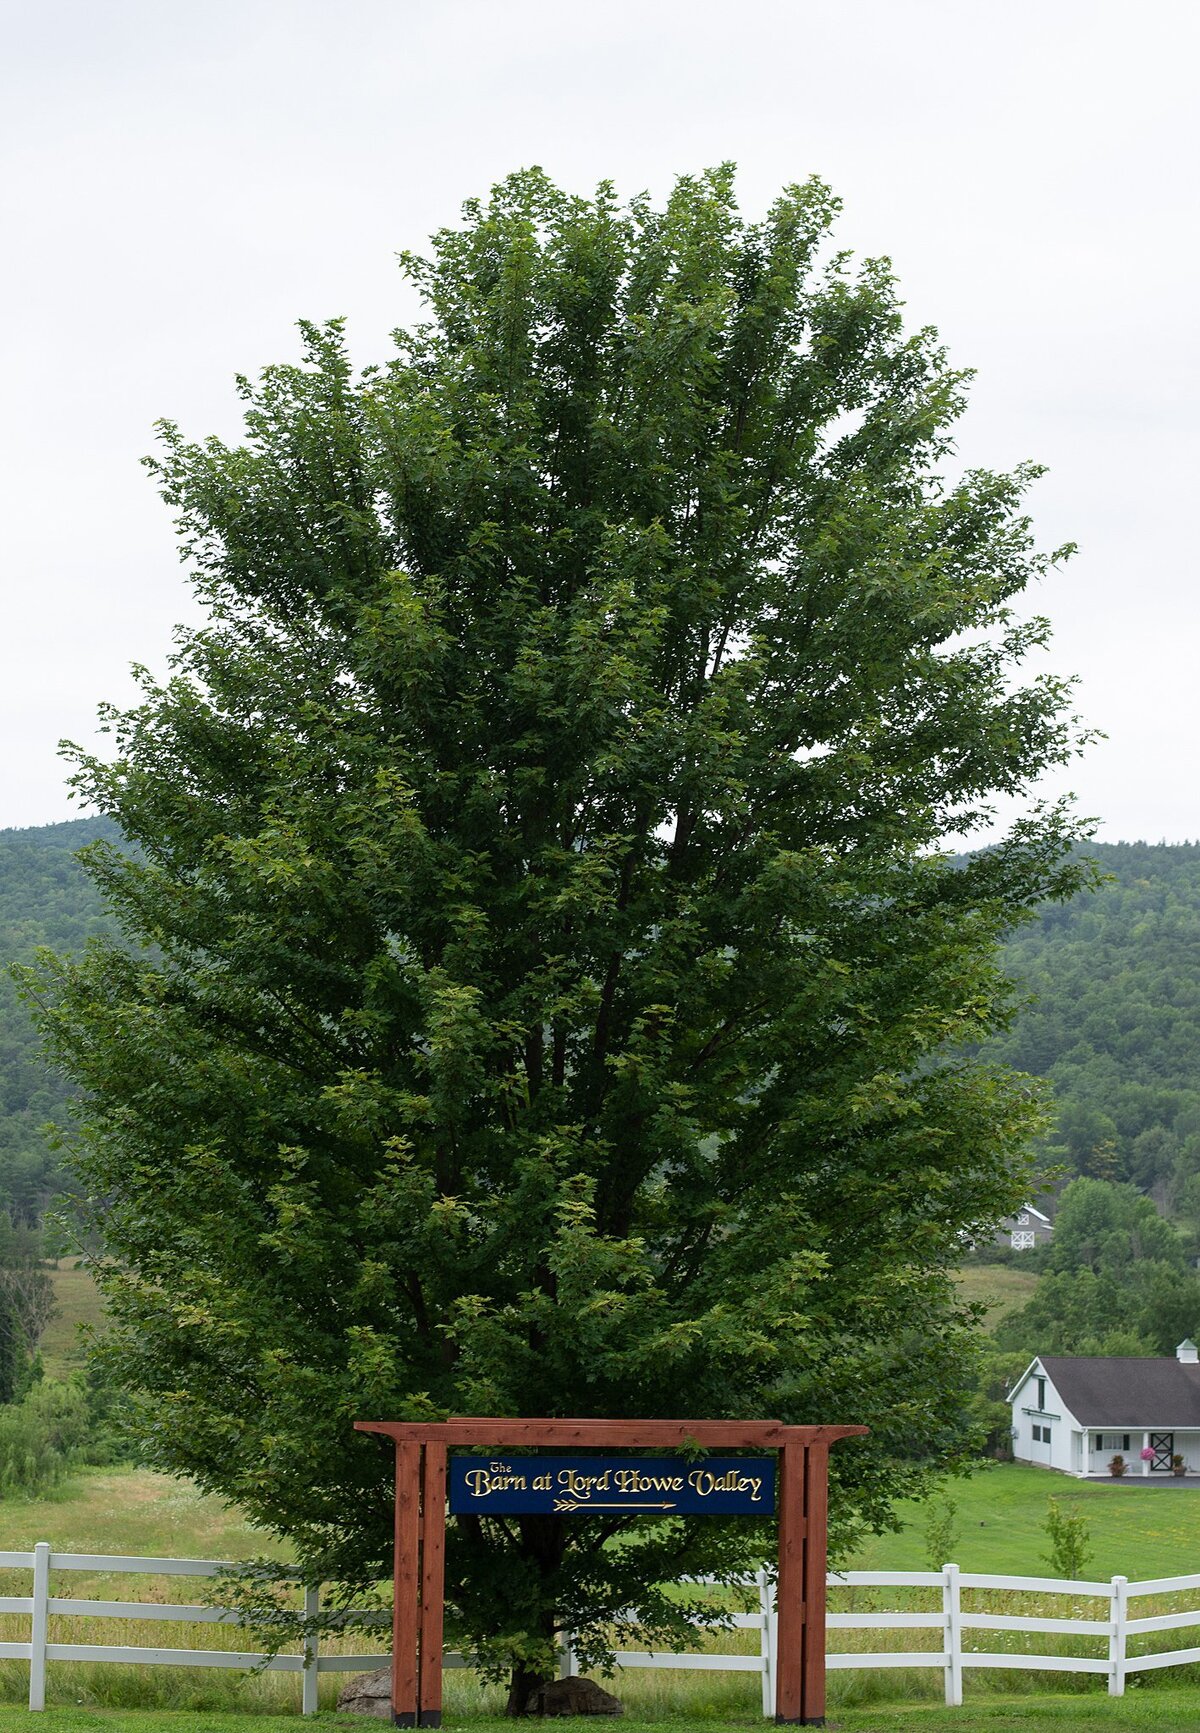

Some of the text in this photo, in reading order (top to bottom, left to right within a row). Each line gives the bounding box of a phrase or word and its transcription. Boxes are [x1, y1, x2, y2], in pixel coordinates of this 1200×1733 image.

[489, 1461, 512, 1474] The
[464, 1469, 763, 1501] Barn at Lord Howe Valley
